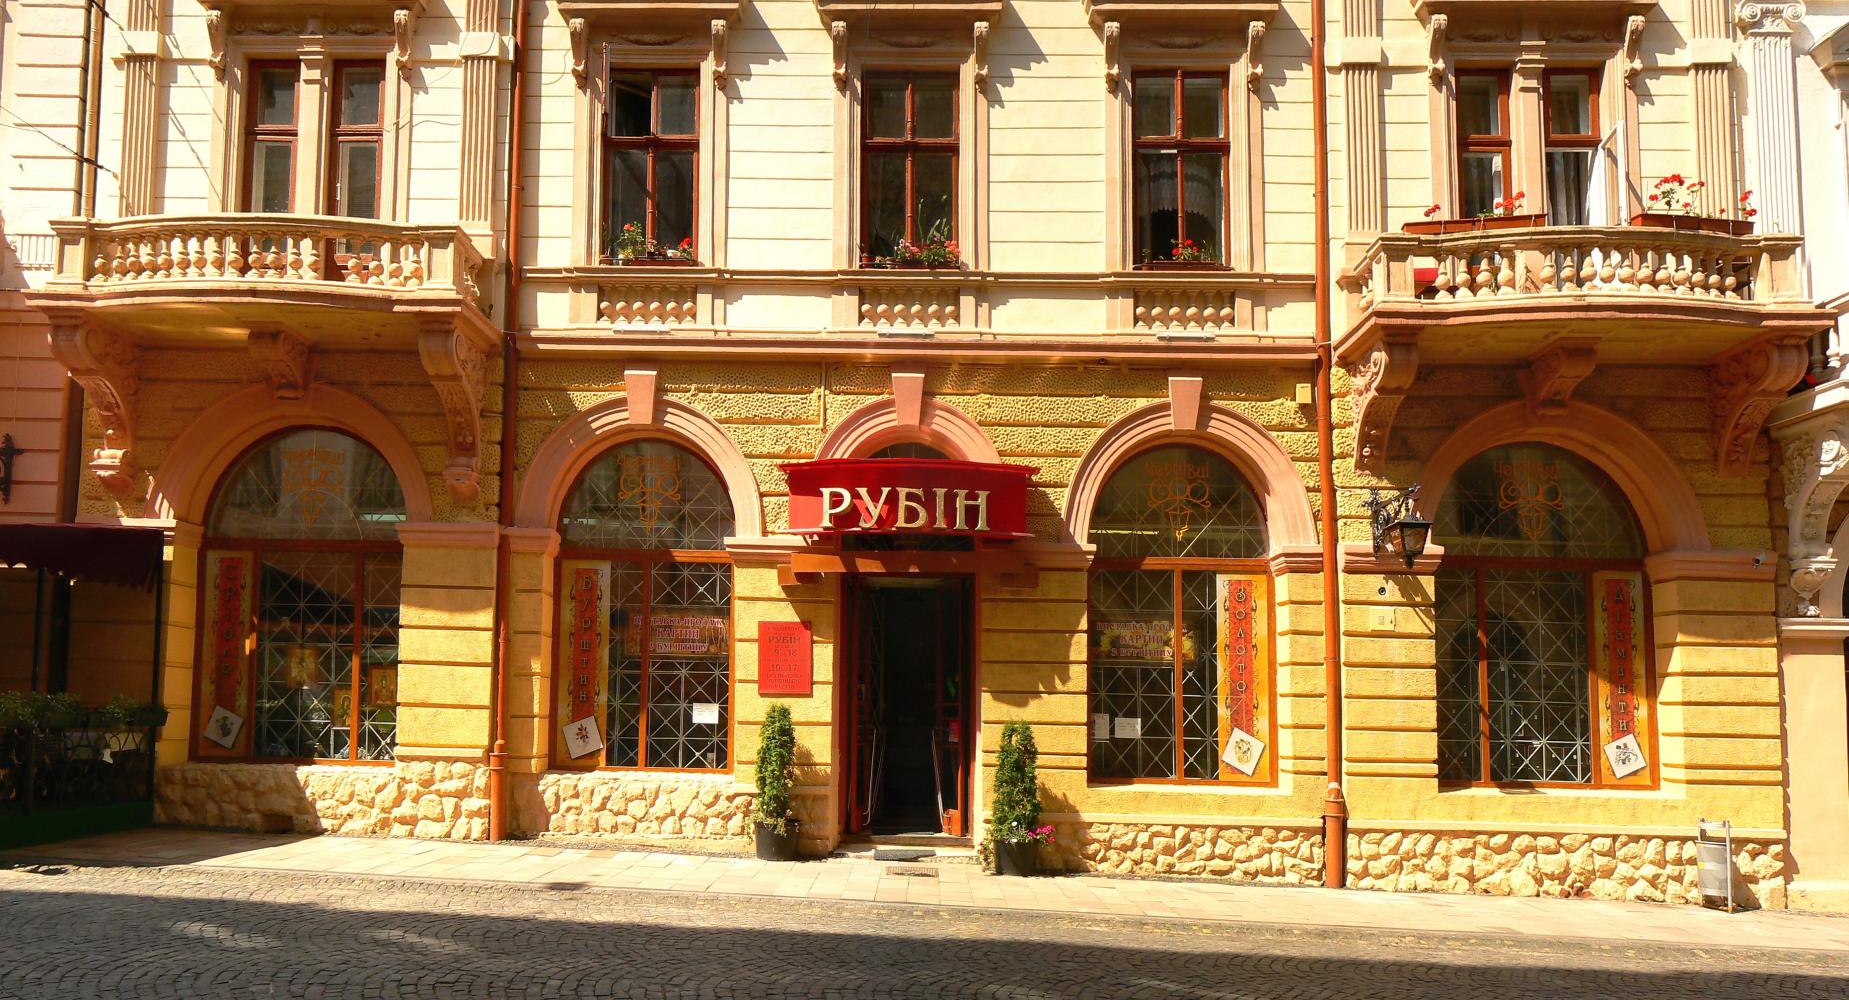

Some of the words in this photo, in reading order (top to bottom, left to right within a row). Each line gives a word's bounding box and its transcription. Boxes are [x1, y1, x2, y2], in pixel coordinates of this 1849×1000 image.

[819, 486, 991, 532] РУБІН
[579, 575, 592, 701] Бурштин
[657, 629, 699, 639] КАРТИН
[768, 636, 801, 644] РУБІН
[1235, 587, 1247, 693] Золото
[1615, 587, 1628, 732] Діаманти
